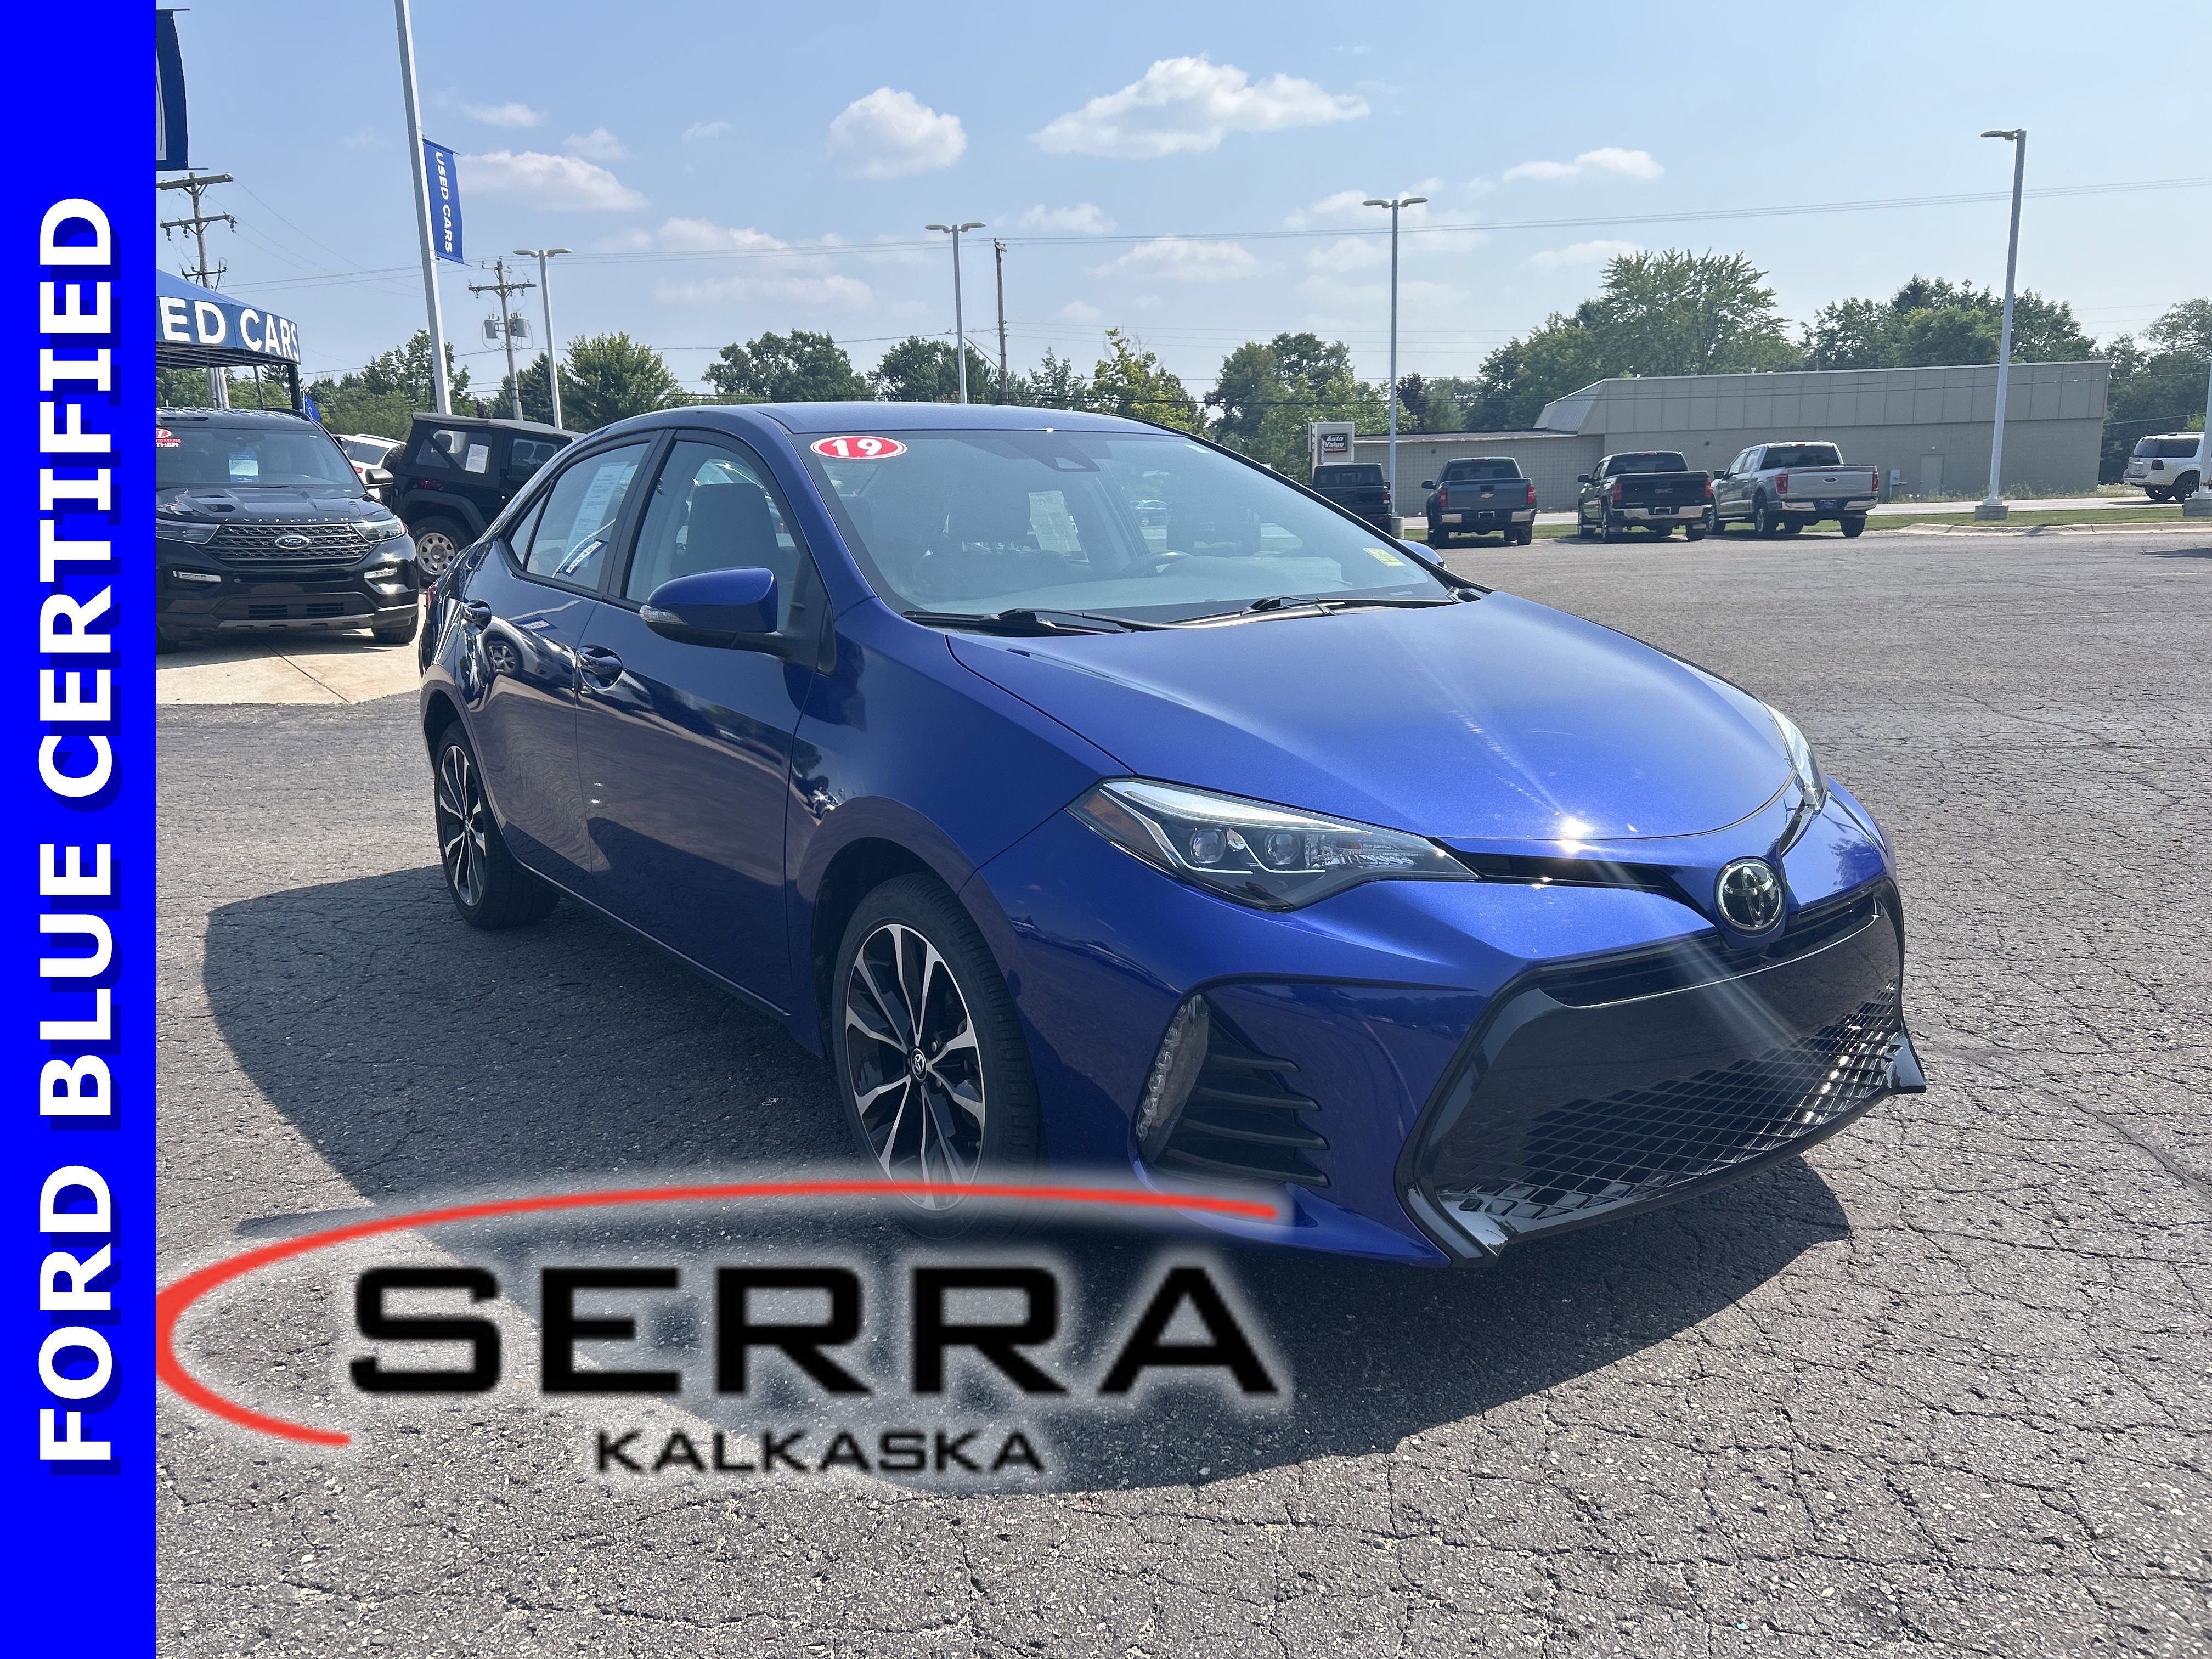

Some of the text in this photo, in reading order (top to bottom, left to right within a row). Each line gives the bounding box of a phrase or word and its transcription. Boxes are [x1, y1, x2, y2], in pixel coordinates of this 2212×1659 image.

[436, 151, 453, 253] USED CARS
[159, 296, 300, 363] ED CARS
[831, 438, 883, 456] 19
